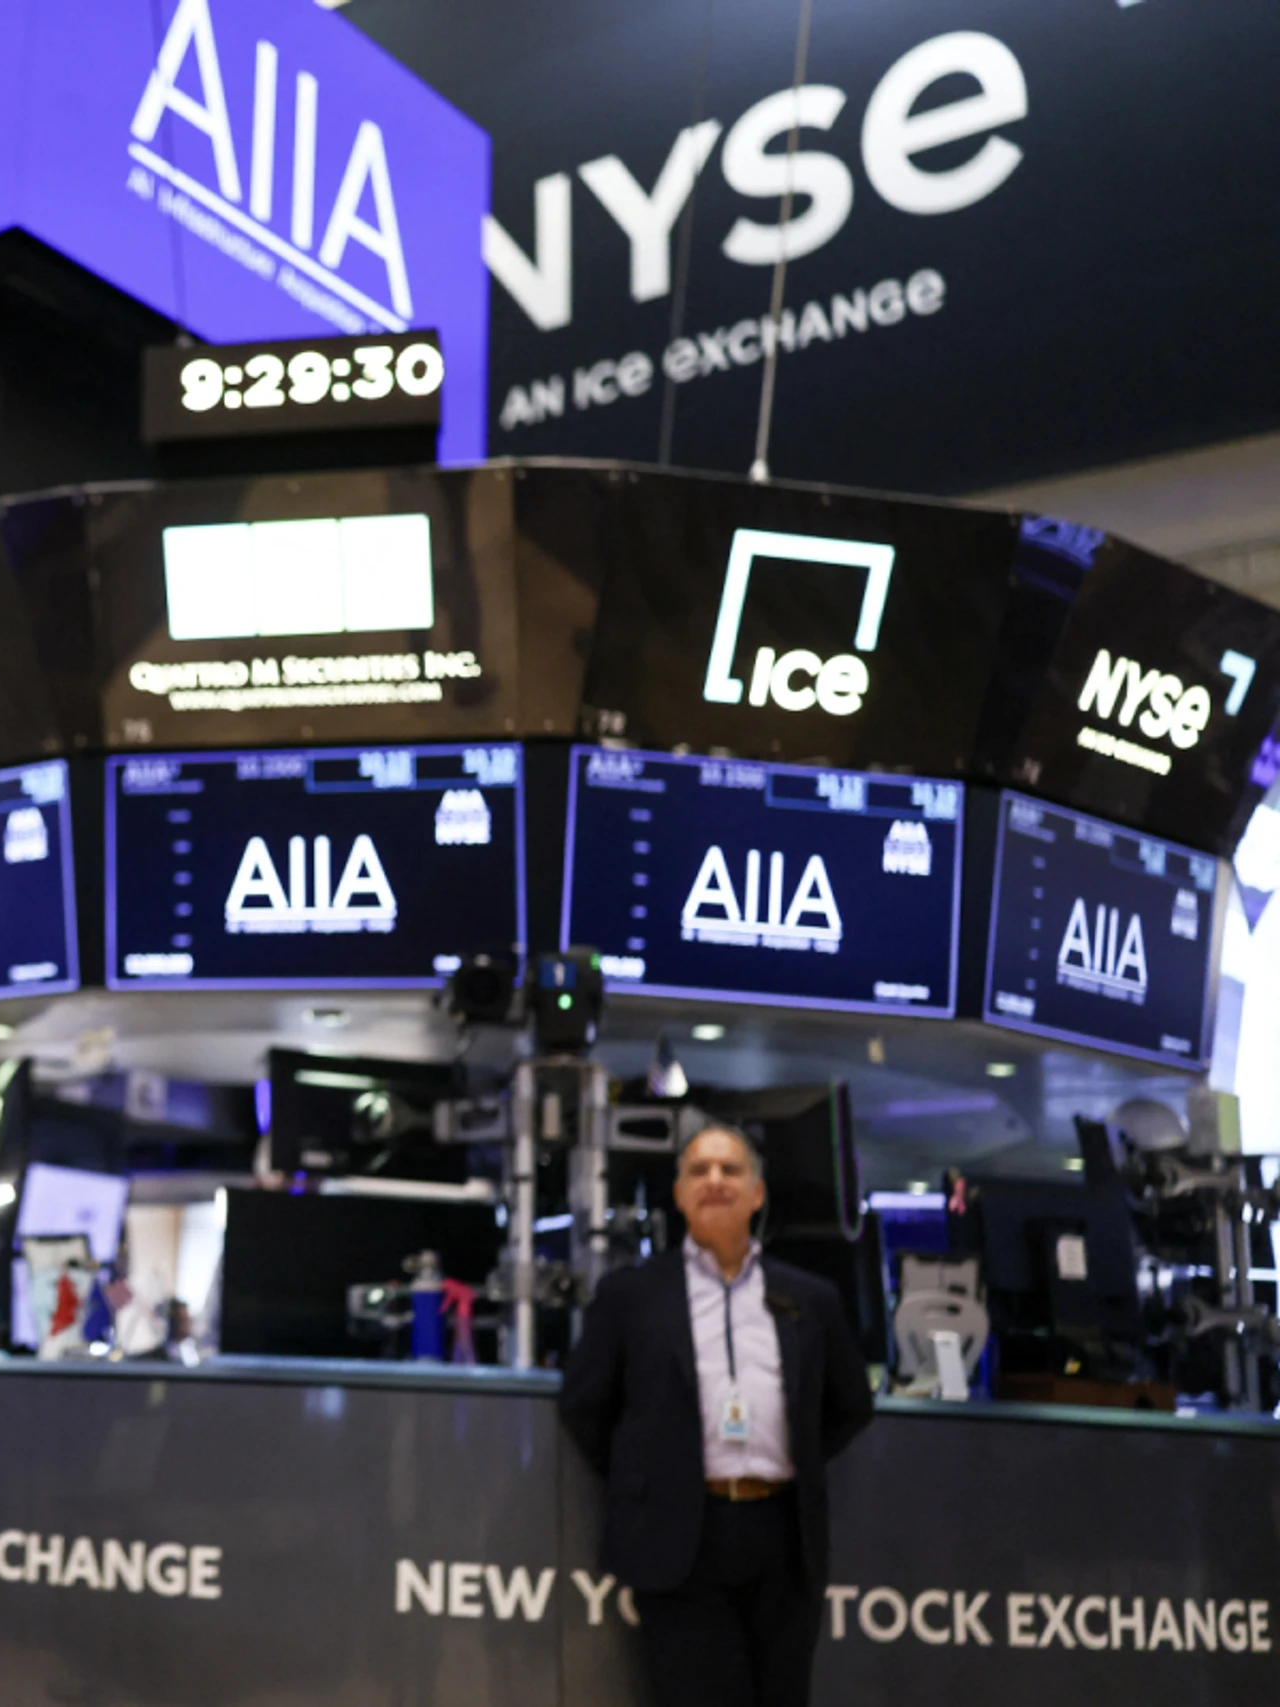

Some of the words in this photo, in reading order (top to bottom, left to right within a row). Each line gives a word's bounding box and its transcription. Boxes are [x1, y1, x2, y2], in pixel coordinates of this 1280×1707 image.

[180, 343, 445, 412] 9:29:30
[225, 834, 397, 909] AIIA
[682, 845, 842, 927] AIIA
[1058, 897, 1148, 986] AIIA
[395, 1557, 556, 1624] NEW
[1006, 1593, 1273, 1653] EXCHANGE
